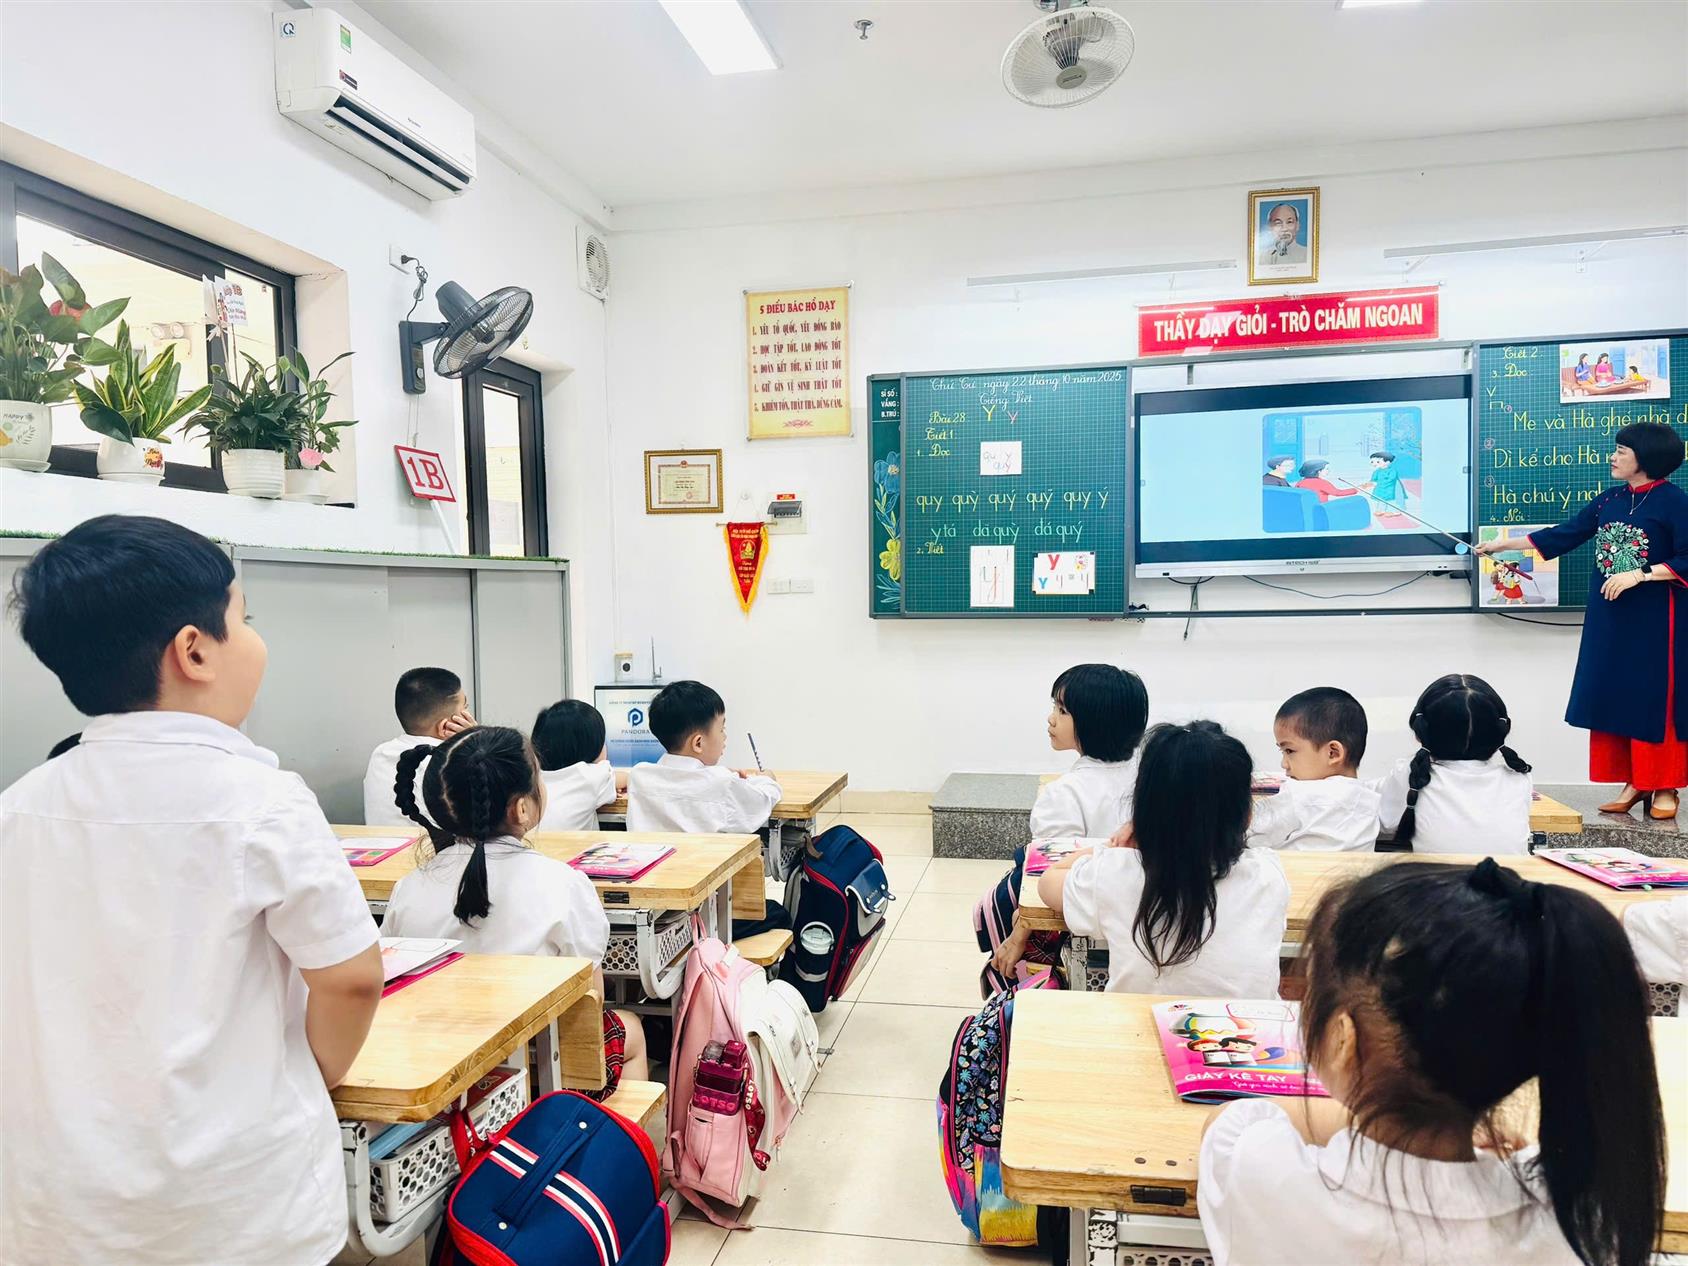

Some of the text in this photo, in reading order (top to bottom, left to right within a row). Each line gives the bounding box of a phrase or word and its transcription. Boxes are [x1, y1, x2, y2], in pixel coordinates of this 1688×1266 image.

[760, 305, 765, 314] 5
[788, 300, 803, 312] BÁC
[805, 297, 816, 311] HỒ
[819, 300, 836, 312] DẠY
[1154, 311, 1194, 341] THẦY
[1199, 320, 1231, 345] DẠY
[1236, 305, 1267, 336] GIỎI
[1279, 306, 1310, 334] TRÒ
[1314, 303, 1360, 331] CHĂM
[1365, 304, 1423, 328] NGOAN
[983, 378, 1009, 394] ngày
[1012, 376, 1027, 387] 22
[1028, 373, 1058, 391] tháng
[1062, 373, 1071, 384] 10
[1072, 374, 1097, 384] năm
[1097, 371, 1122, 383] 2025
[952, 412, 966, 423] 28
[982, 404, 996, 422] Y
[1544, 414, 1566, 430] và
[1573, 408, 1595, 429] Hà
[1601, 406, 1631, 436] ghé
[1637, 405, 1670, 424] nhà
[1494, 448, 1512, 468] Dì
[1544, 446, 1574, 466] cho
[1578, 444, 1600, 464] Hà
[407, 456, 444, 490] 1B
[916, 495, 943, 514] quy
[952, 490, 979, 513] quỳ
[988, 489, 1016, 512] quý
[1063, 491, 1092, 511] quy
[1098, 486, 1109, 509] ý
[1493, 484, 1517, 505] Hà
[1522, 482, 1555, 504] chú
[1559, 485, 1571, 510] ý
[931, 527, 941, 545] y
[944, 524, 957, 537] tá
[993, 522, 1020, 545] quỳ
[1034, 517, 1052, 536] đá
[1056, 520, 1083, 544] quý
[693, 1094, 737, 1112] LOTSO
